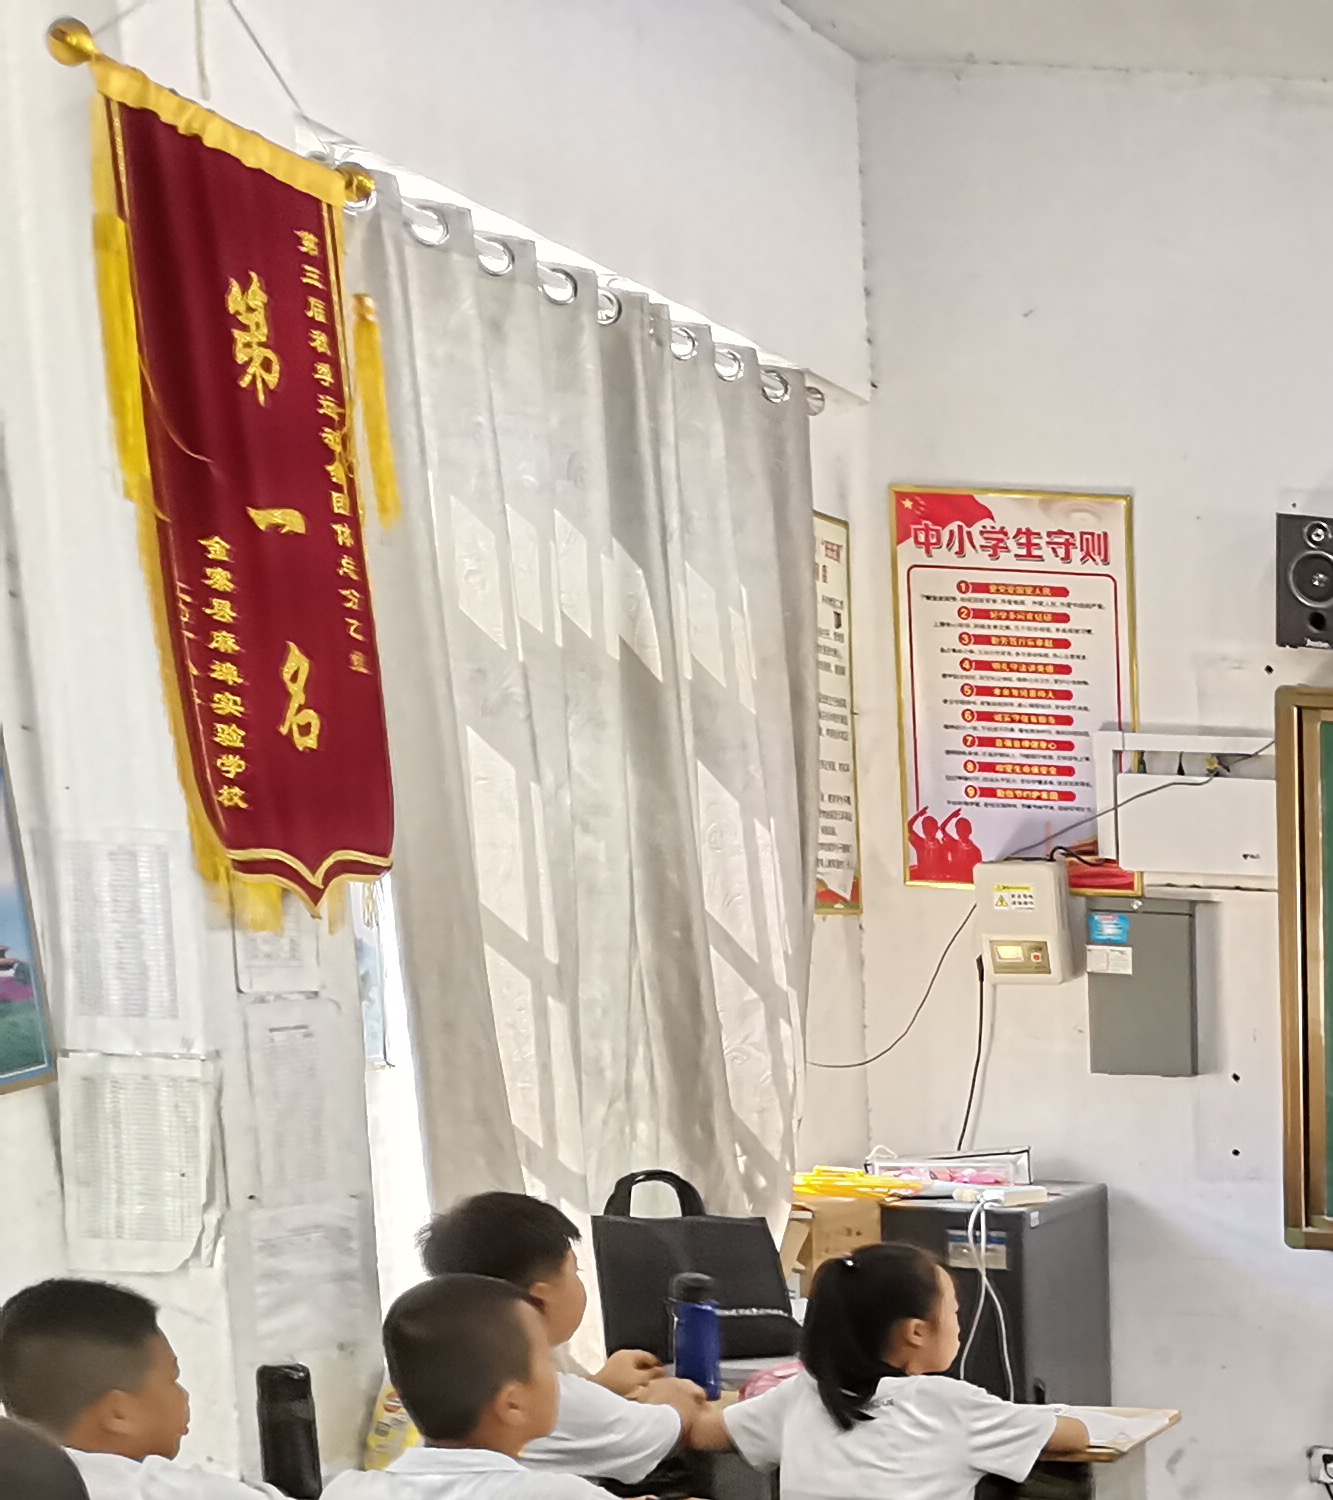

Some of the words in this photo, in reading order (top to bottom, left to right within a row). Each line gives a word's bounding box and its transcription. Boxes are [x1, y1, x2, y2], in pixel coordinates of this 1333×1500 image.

[225, 270, 324, 752] 第一名
[911, 520, 1112, 565] 中小学生守则
